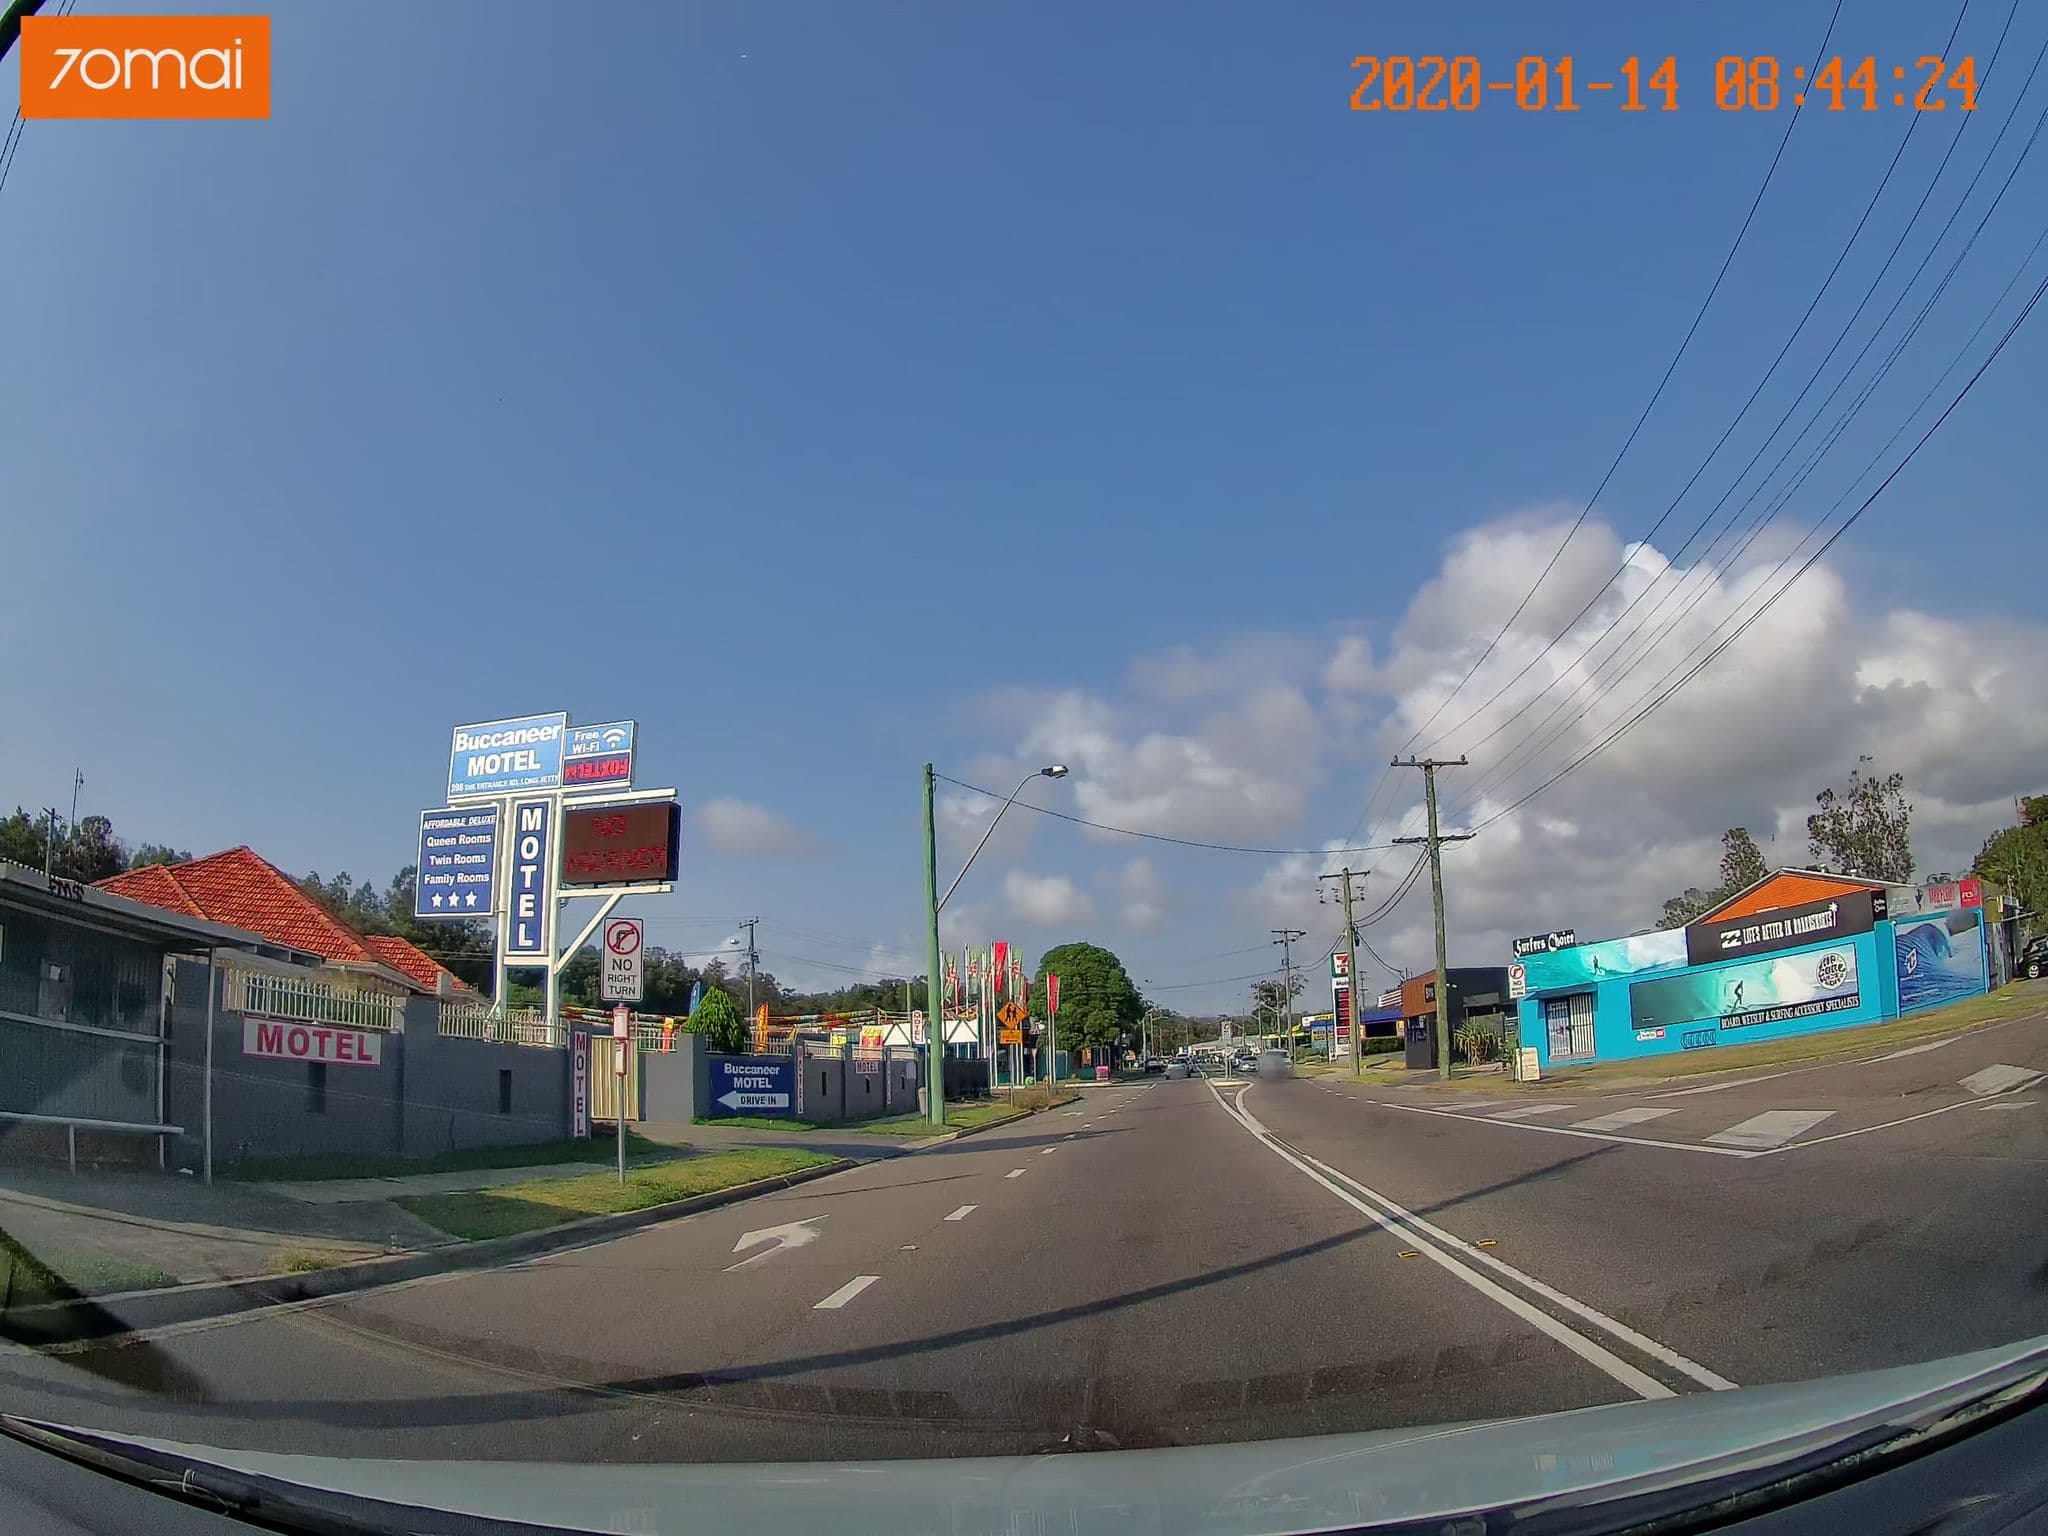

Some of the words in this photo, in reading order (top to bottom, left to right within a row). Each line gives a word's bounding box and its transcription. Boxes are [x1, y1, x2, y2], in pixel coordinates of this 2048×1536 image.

[455, 724, 563, 752] Buccaneer
[574, 731, 600, 741] Free
[467, 750, 542, 777] MOTEL
[423, 818, 466, 830] AFFORDABLE
[469, 815, 496, 825] DELUXE
[427, 836, 456, 848] Queen
[458, 833, 492, 845] Rooms
[429, 855, 452, 866] Twin
[453, 853, 487, 865] Rooms
[424, 873, 455, 887] Family
[457, 872, 490, 884] Rooms
[518, 808, 543, 946] MOTEL
[1515, 940, 1546, 957] Surfers
[1548, 932, 1575, 951] Choice
[612, 958, 633, 971] NO
[607, 973, 637, 984] RIGHT
[608, 985, 636, 996] TURN
[1825, 996, 1859, 1012] SPECIALISTS
[257, 1024, 373, 1061] MOTEL
[724, 1063, 780, 1075] Buccaneer
[856, 1062, 878, 1072] MOTEL
[576, 1033, 586, 1134] MOTEL
[733, 1077, 772, 1089] MOTEL
[740, 1096, 765, 1105] DRIVE
[767, 1096, 777, 1105] IN
